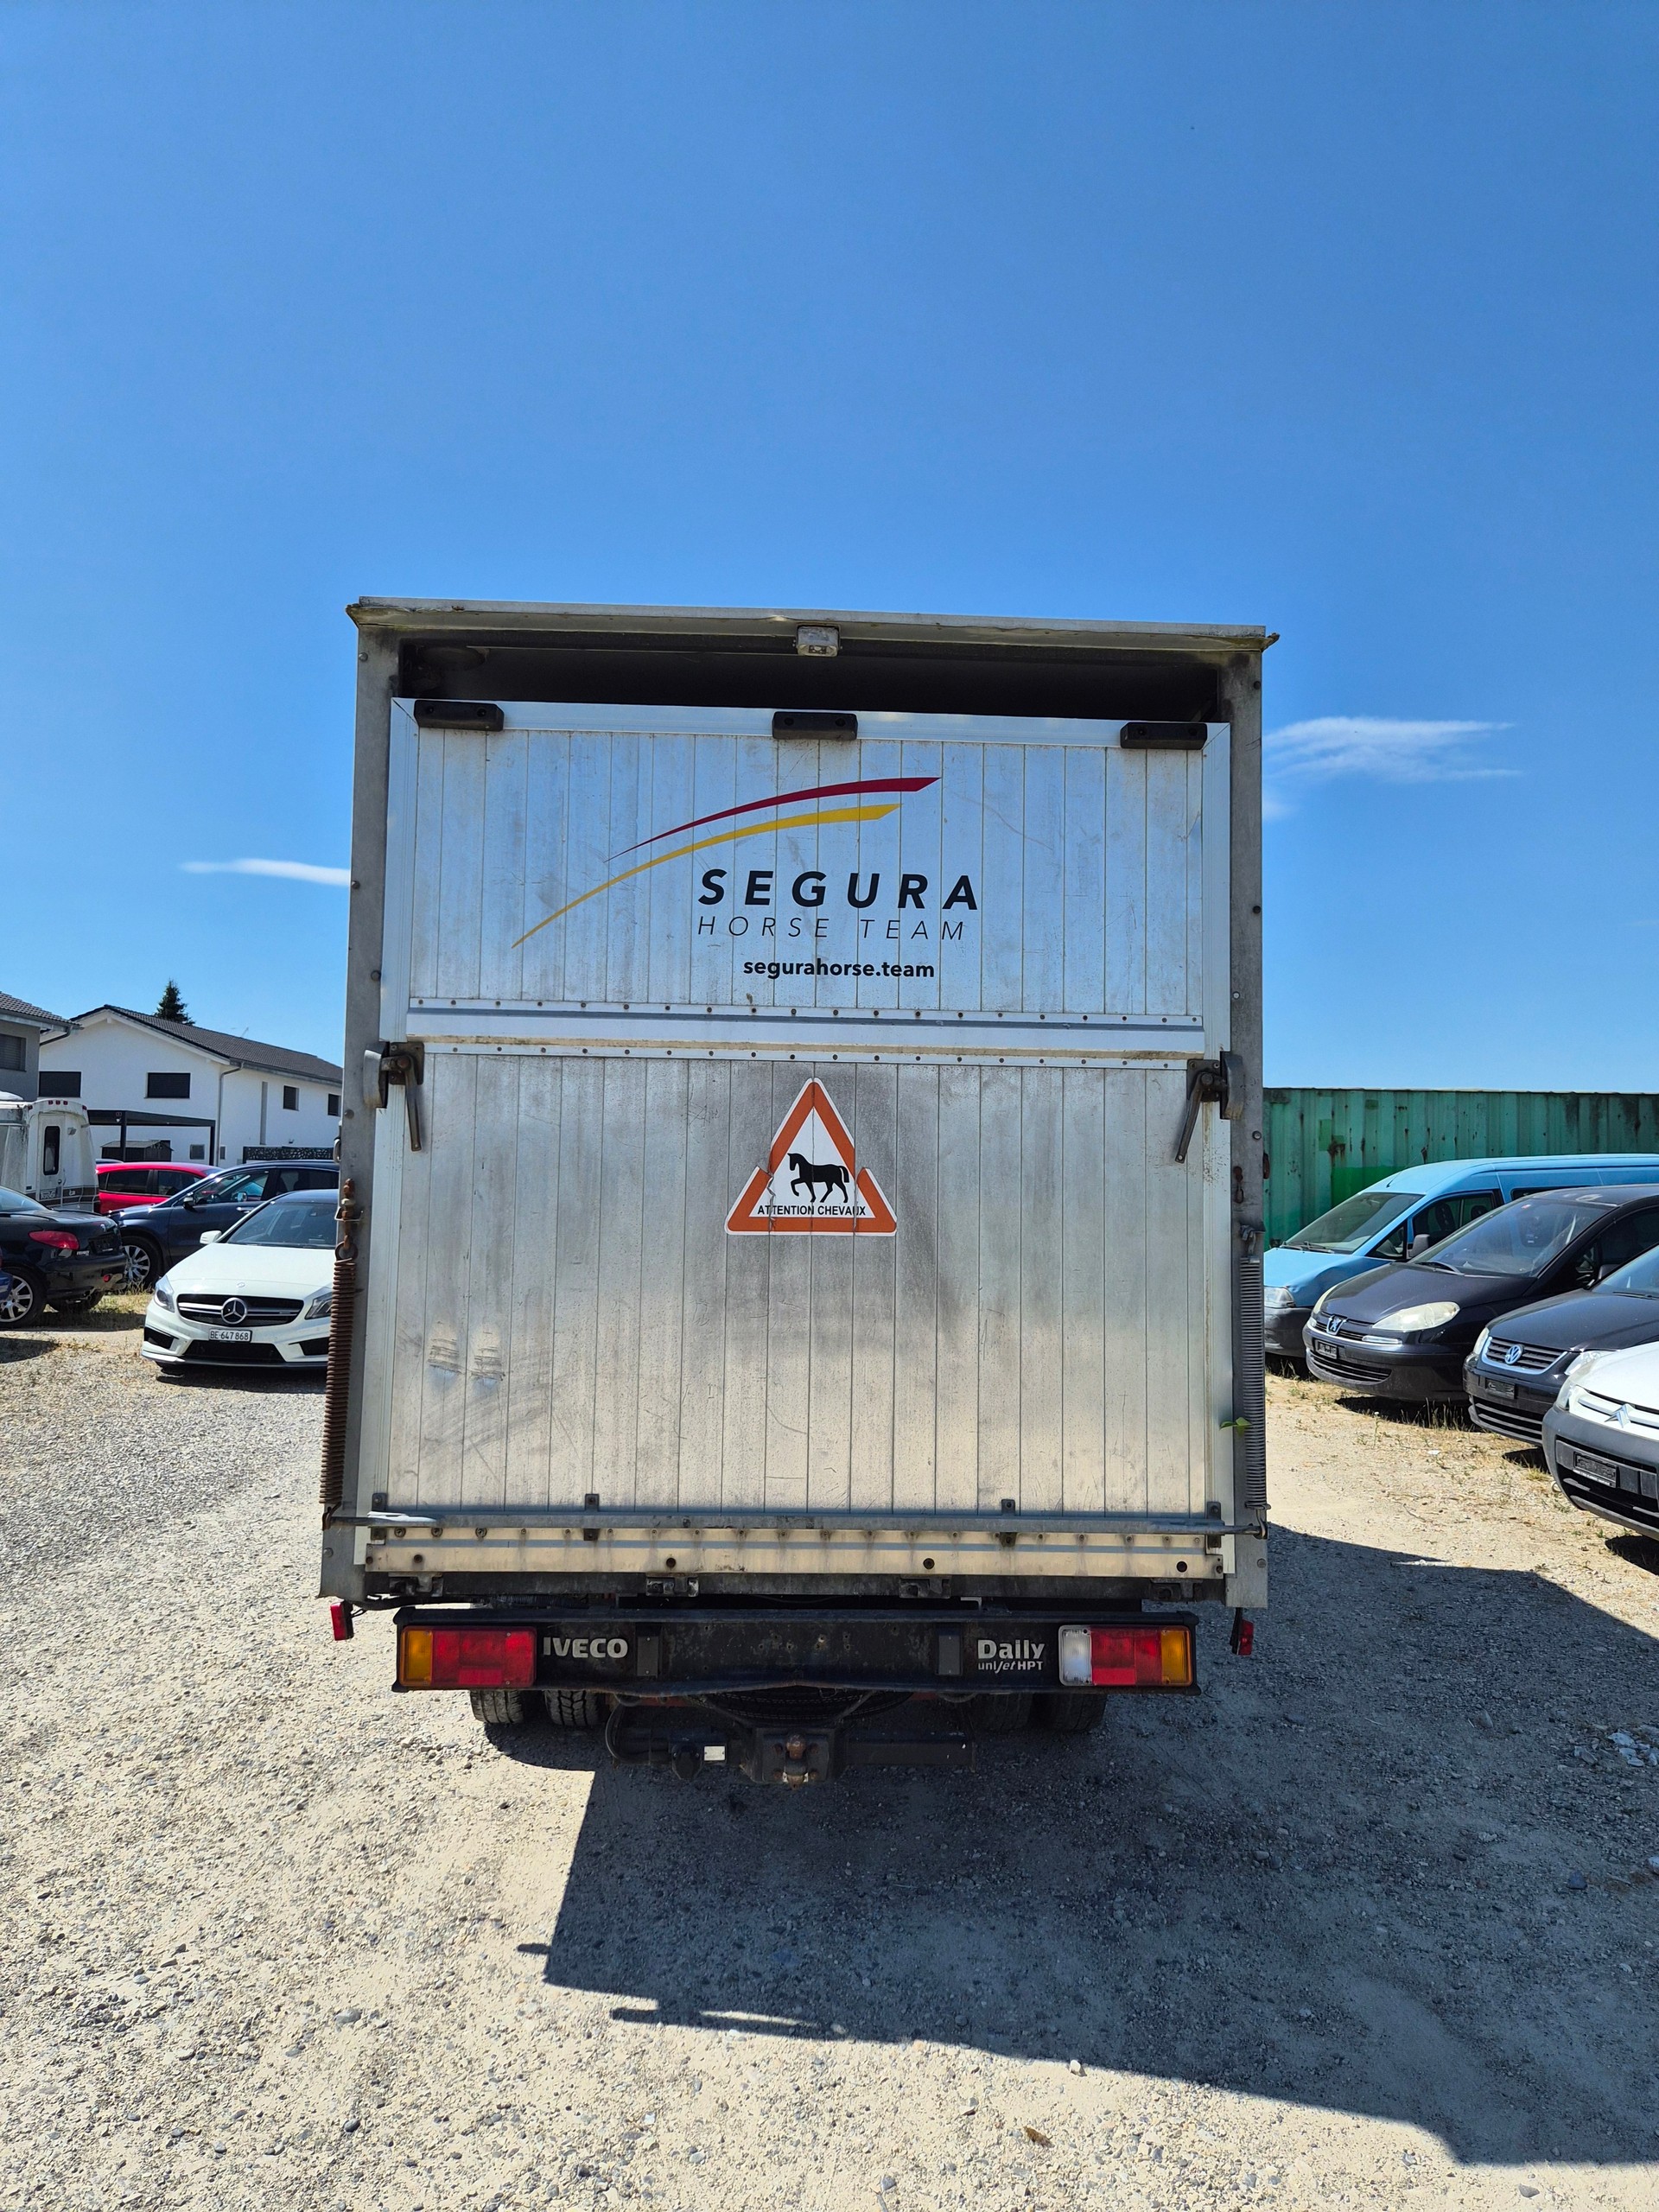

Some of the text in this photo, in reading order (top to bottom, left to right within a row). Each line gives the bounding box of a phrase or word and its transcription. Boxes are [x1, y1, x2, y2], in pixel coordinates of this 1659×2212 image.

[698, 868, 978, 910] SEGURA
[698, 916, 963, 941] HORSE TEAM
[743, 957, 935, 980] segurahorse.team
[757, 1205, 815, 1216] ATTENTION
[543, 1637, 628, 1659] IVECO
[977, 1639, 1046, 1659] Daily
